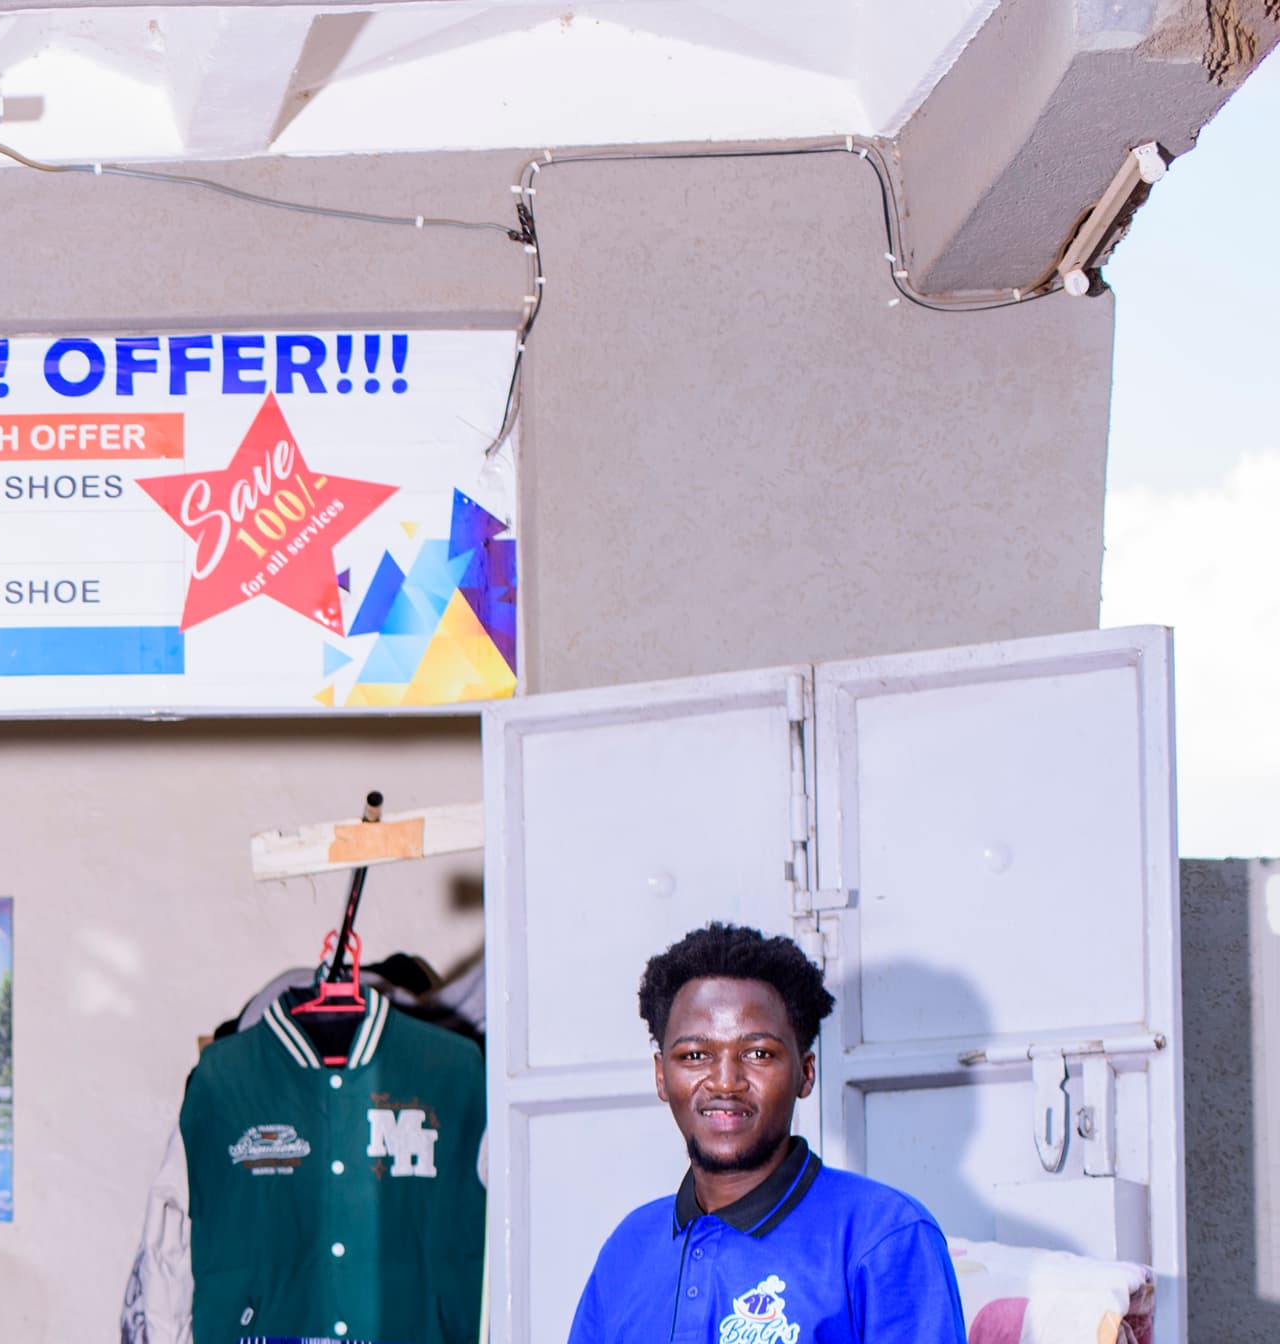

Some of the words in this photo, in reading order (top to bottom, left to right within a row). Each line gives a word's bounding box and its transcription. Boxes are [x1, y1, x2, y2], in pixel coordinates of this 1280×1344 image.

[43, 335, 409, 398] OFFER!!!
[30, 424, 146, 450] OFFER
[4, 475, 123, 500] SHOES
[180, 440, 295, 580] Save
[236, 473, 328, 560] 100/-
[240, 572, 267, 598] for
[267, 550, 289, 576] all
[287, 499, 345, 556] services
[4, 580, 101, 605] SHOE
